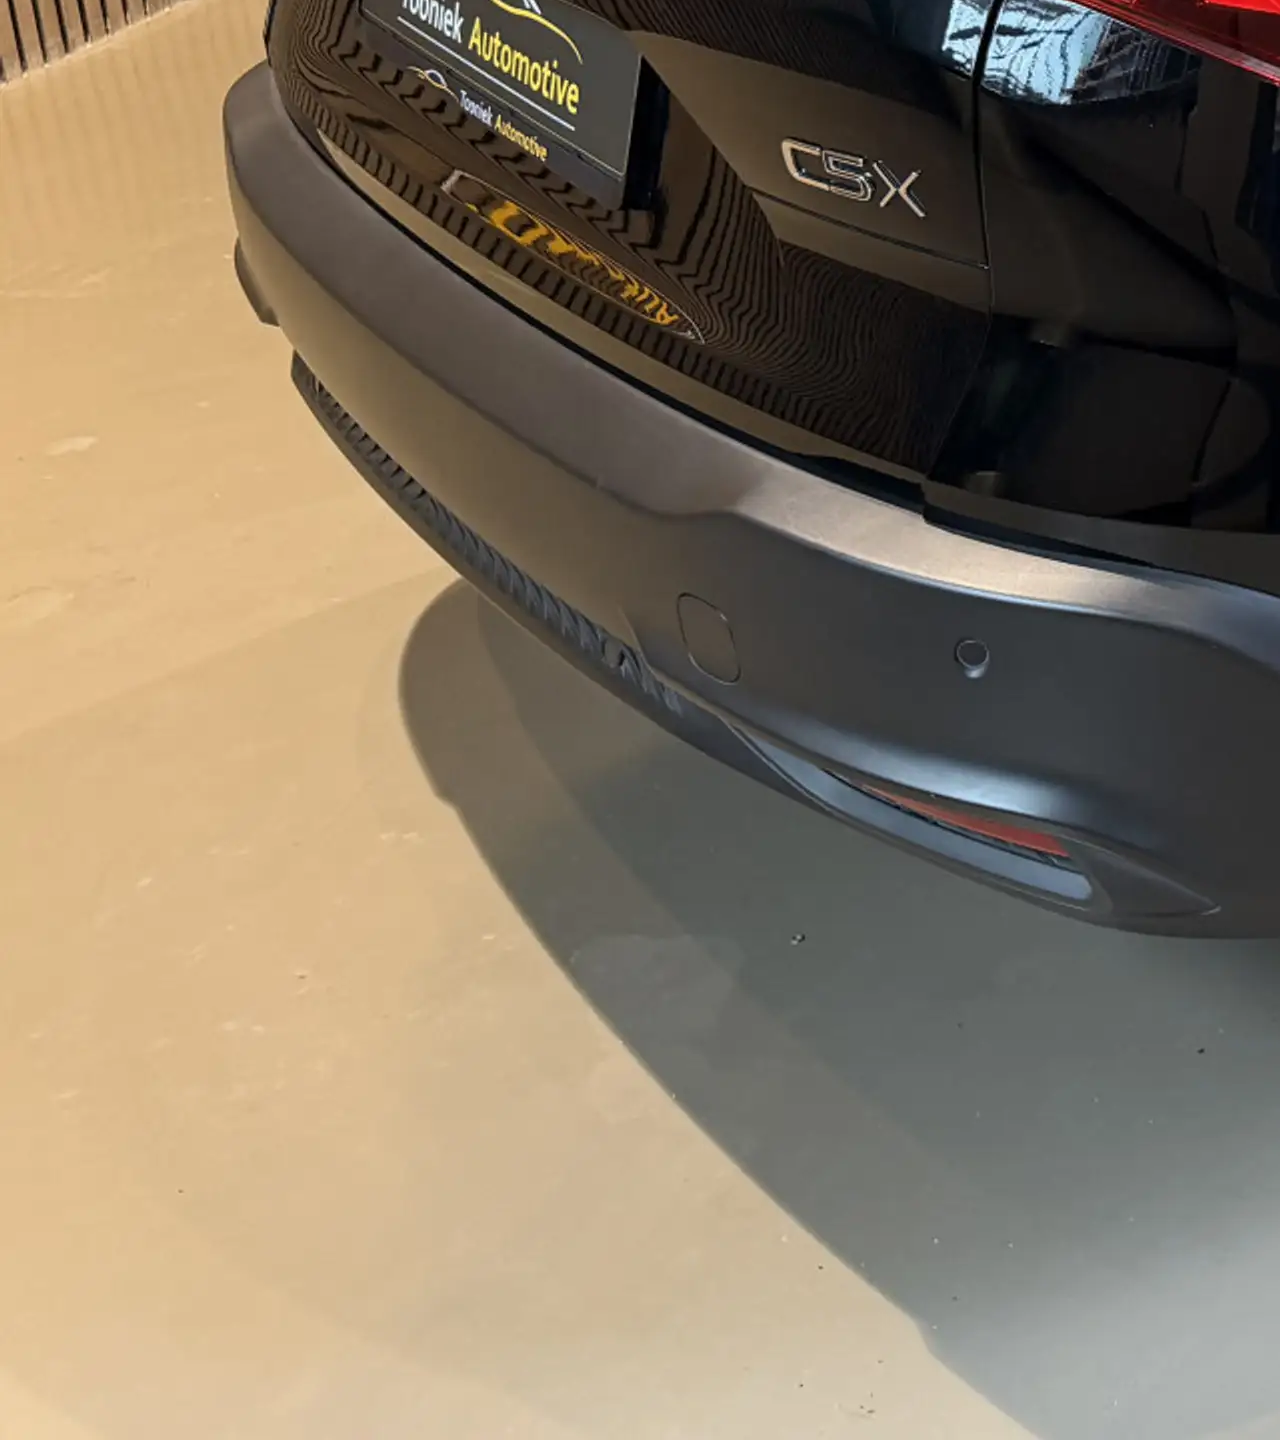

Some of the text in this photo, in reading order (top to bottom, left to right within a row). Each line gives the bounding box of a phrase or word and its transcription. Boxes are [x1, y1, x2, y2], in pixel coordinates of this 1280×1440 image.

[468, 16, 580, 115] Automotive
[459, 89, 549, 162] Tooniek Automotive
